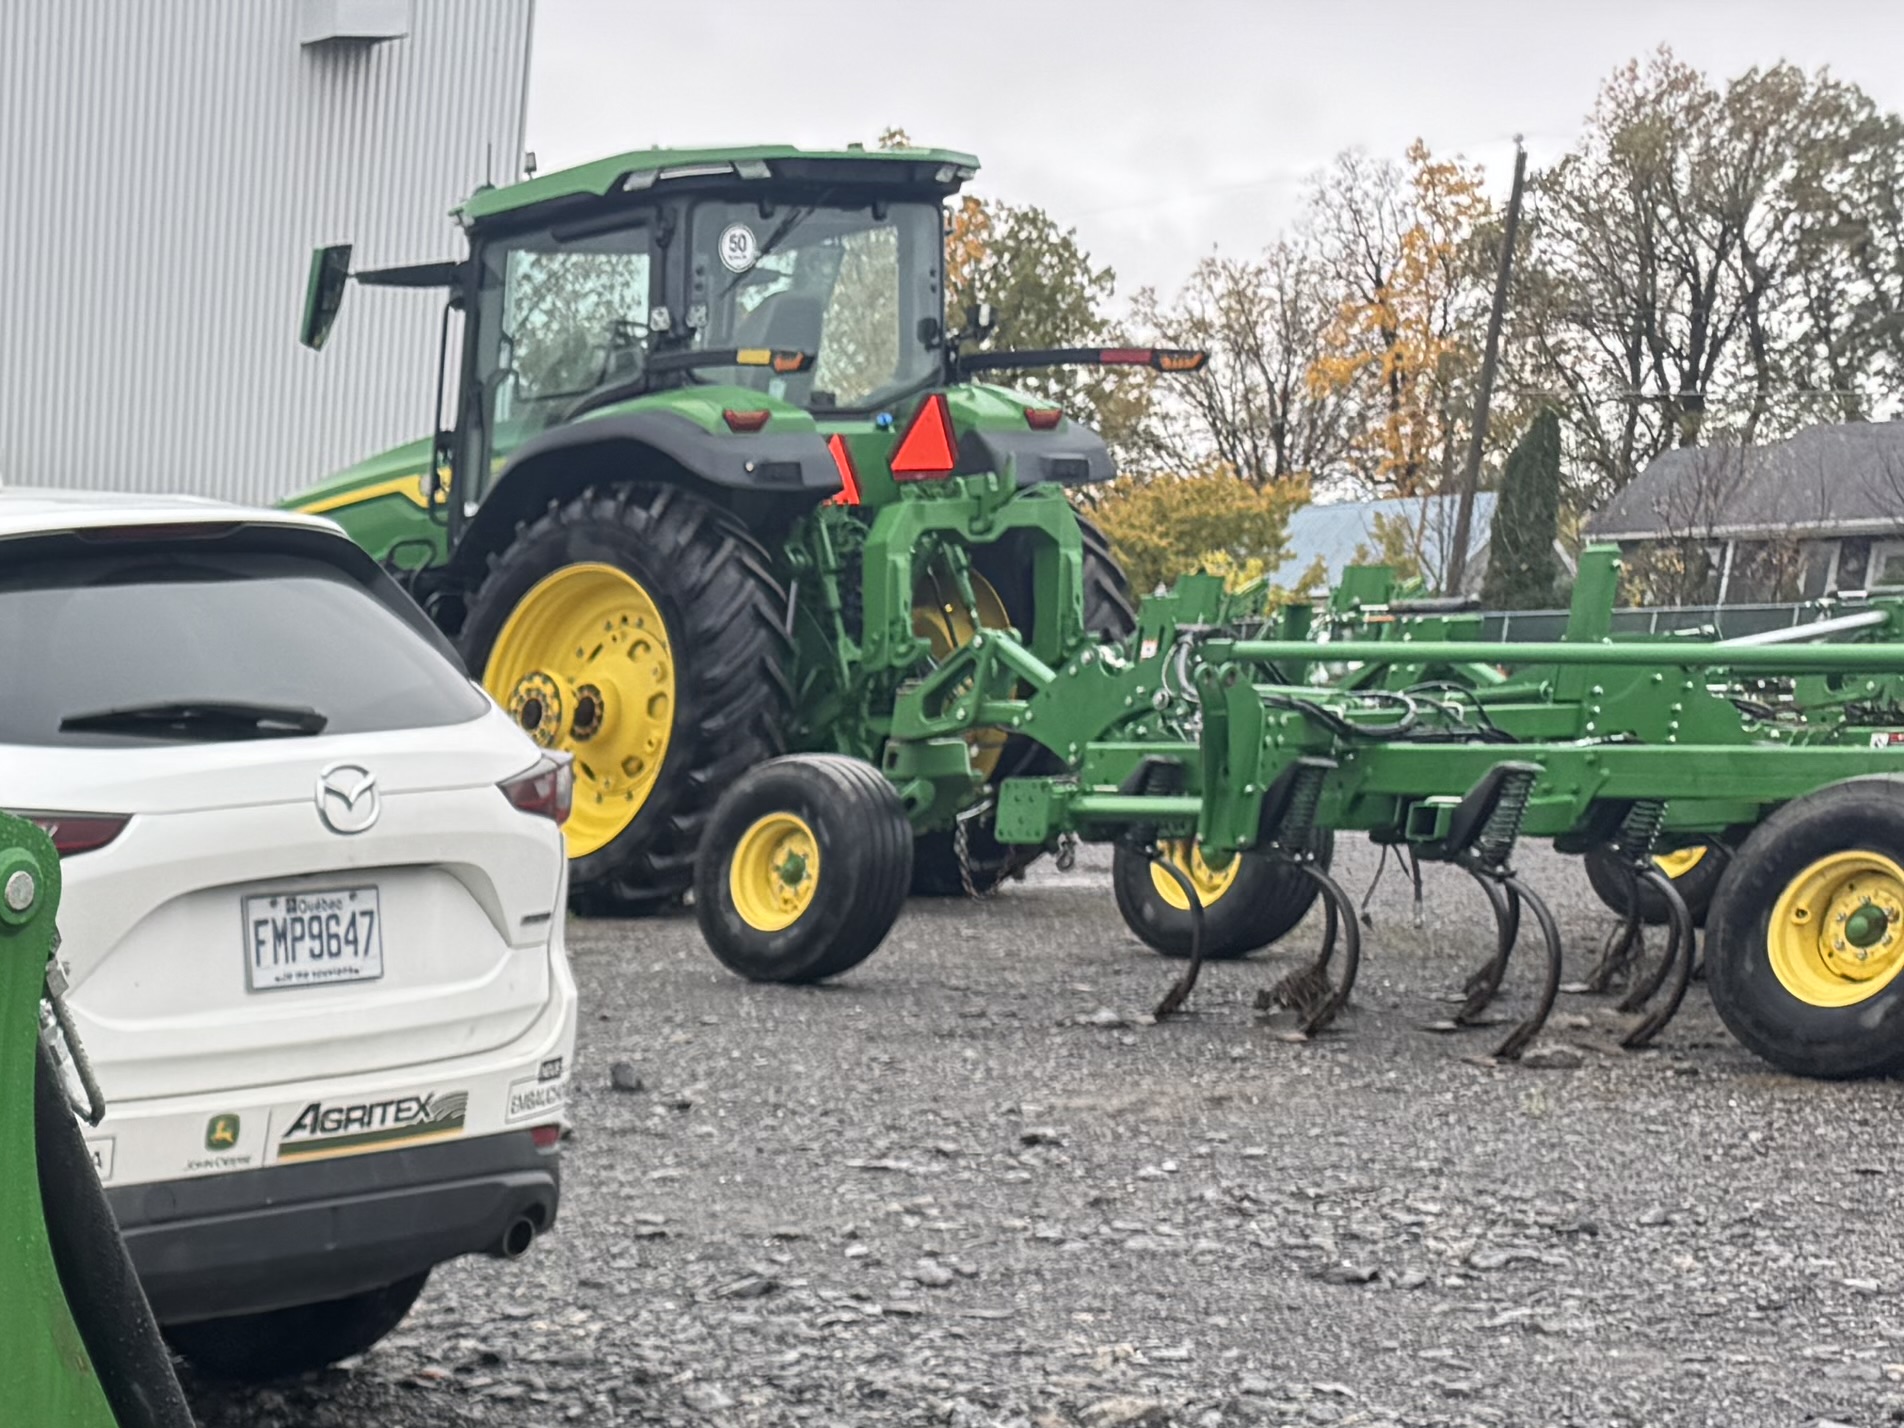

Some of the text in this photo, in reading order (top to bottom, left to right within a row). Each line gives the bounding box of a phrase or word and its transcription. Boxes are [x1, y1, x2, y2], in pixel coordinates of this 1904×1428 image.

[729, 233, 747, 253] 50
[298, 898, 342, 913] Québec
[253, 910, 374, 967] FMP9647
[283, 1091, 434, 1138] AGRITEX
